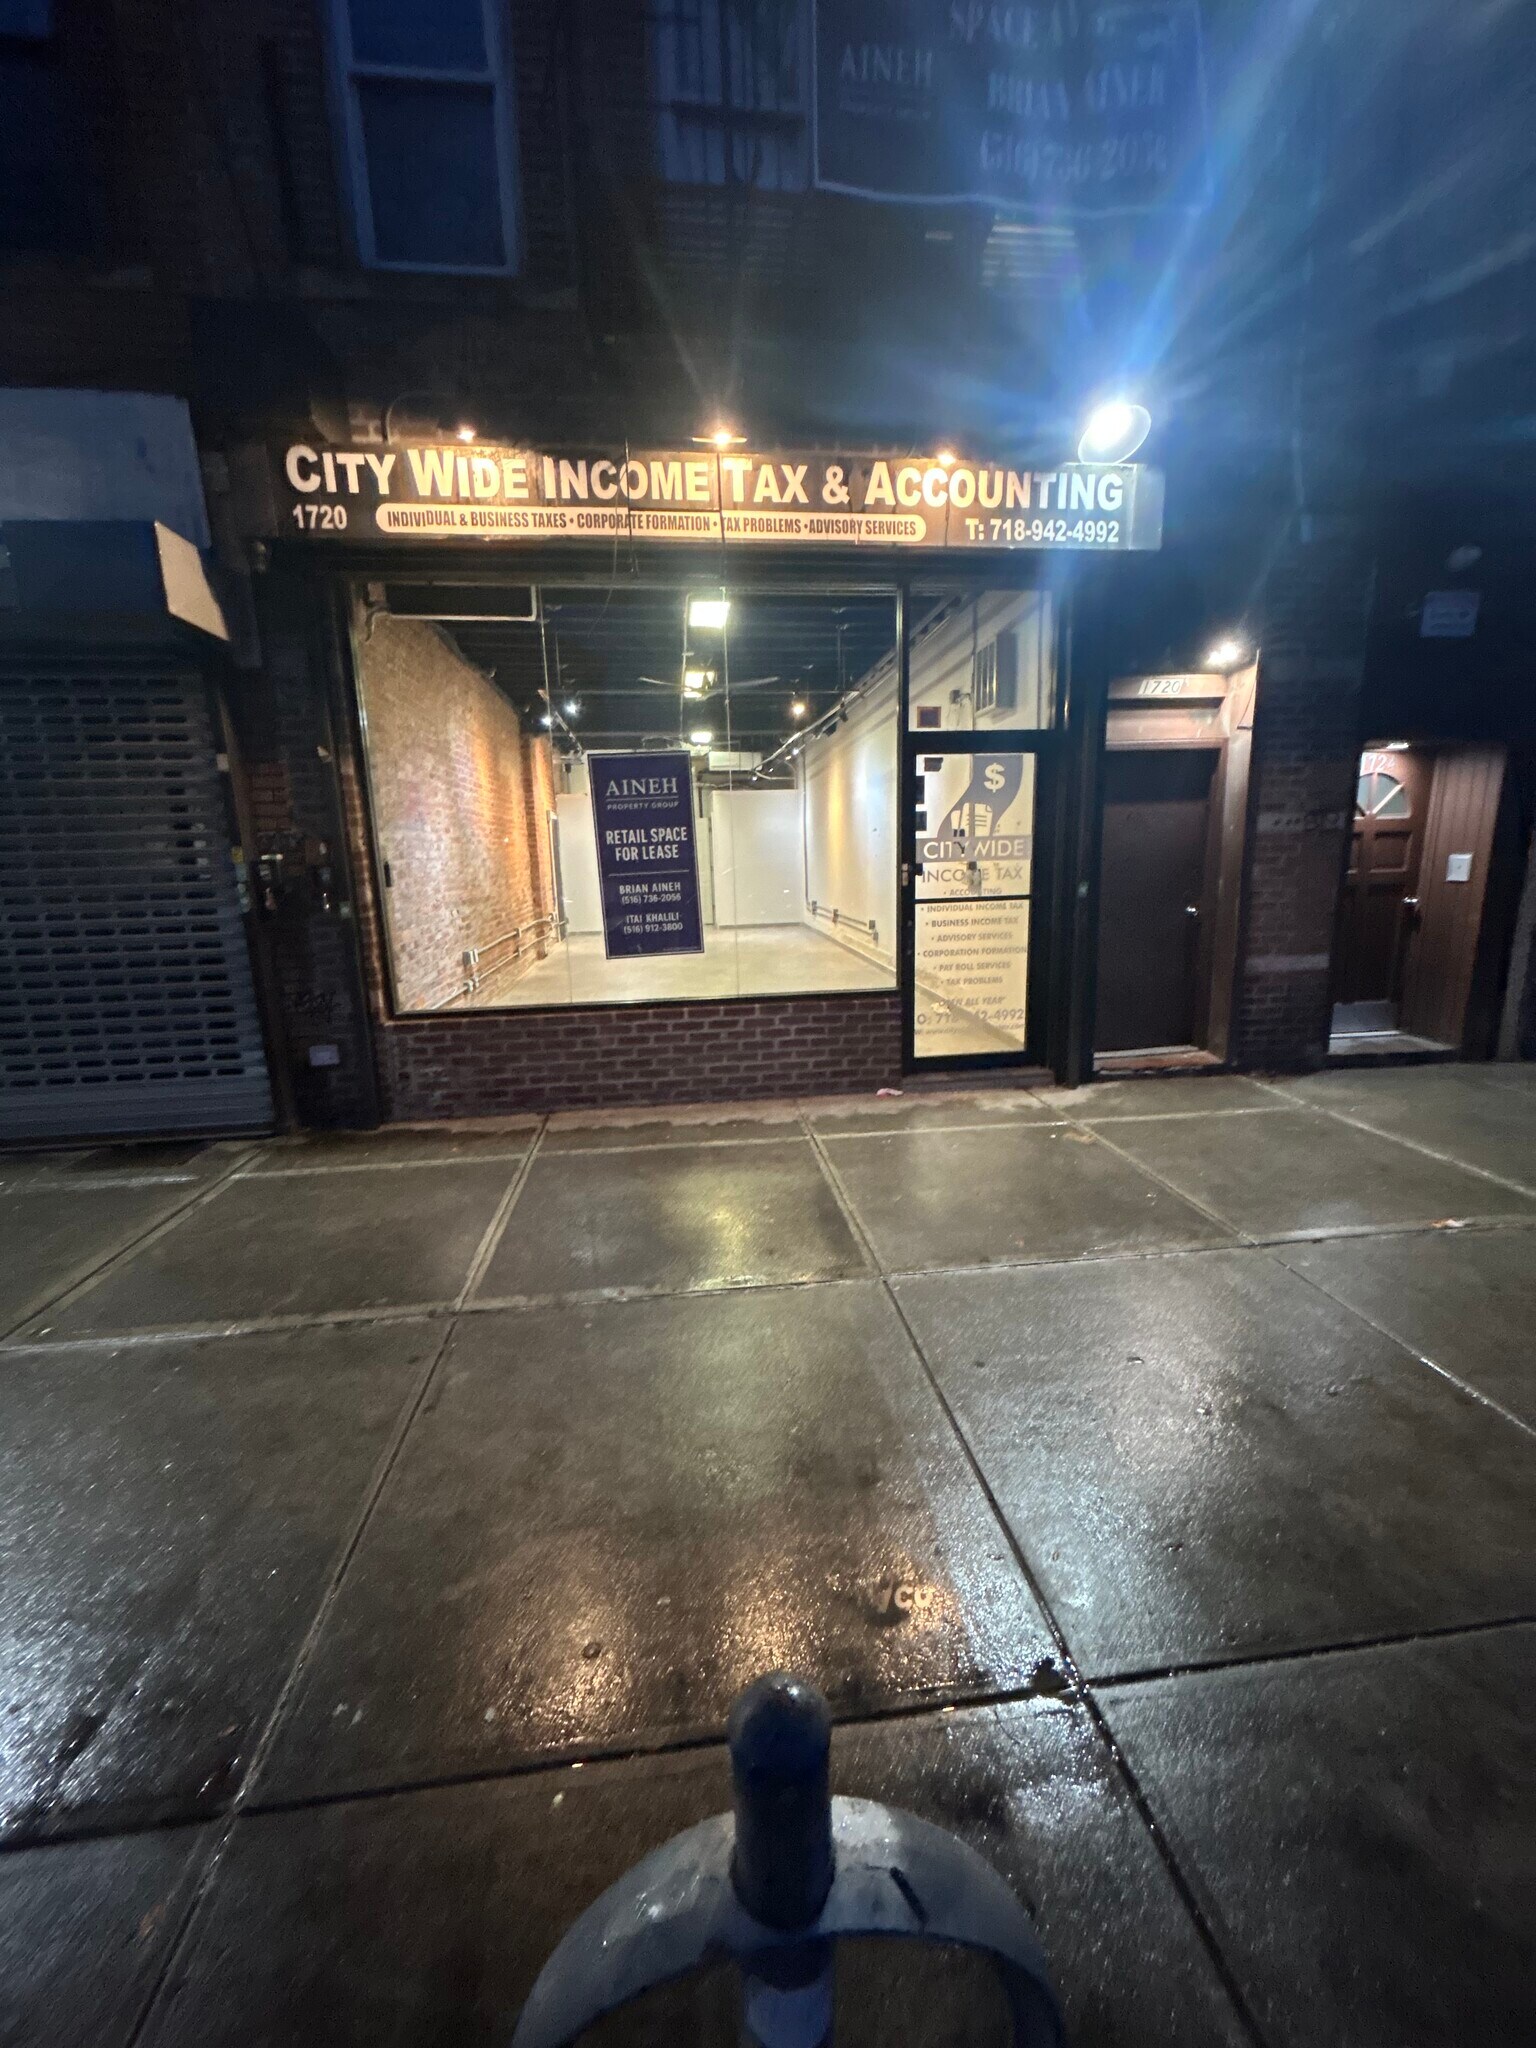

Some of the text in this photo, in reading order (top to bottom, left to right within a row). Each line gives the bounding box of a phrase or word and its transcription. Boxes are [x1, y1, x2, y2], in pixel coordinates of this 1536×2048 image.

[285, 444, 1123, 511] CITY WIDE INCOME TAX & ACCOUNTING
[292, 503, 348, 530] 1720
[387, 510, 917, 536] INDIVIDUAL & BUSINESS TAXES CORPORATE FORMATION TAX PROBLEMS ADVISORY SERVICES
[965, 518, 1120, 543] T: 718-942-4992
[1142, 680, 1181, 694] 1720
[605, 777, 678, 796] AINEH
[607, 801, 680, 811] PROPERTY GROUP
[606, 827, 688, 845] RETAIL SPACE
[615, 844, 680, 862] FOR LEASE
[923, 839, 1025, 859] CITY WIDE
[921, 865, 1023, 883] INCOE TAX
[619, 881, 681, 895] BRIAN AINEH
[621, 894, 642, 905] (516)
[927, 901, 1023, 913] INDIVIDUAL INCOME TAX
[626, 912, 680, 924] ITAI KHALILI
[931, 916, 1019, 928] BUSINESS INCOME TAX
[623, 922, 683, 935] (516) 912-3800
[937, 931, 1013, 943] ADVISORY SERVICES
[922, 945, 1027, 958] CORPORATION FORMATION
[939, 960, 1012, 972] PAY ROLL SERVICES
[946, 976, 1003, 986] TAX PROBLEMS
